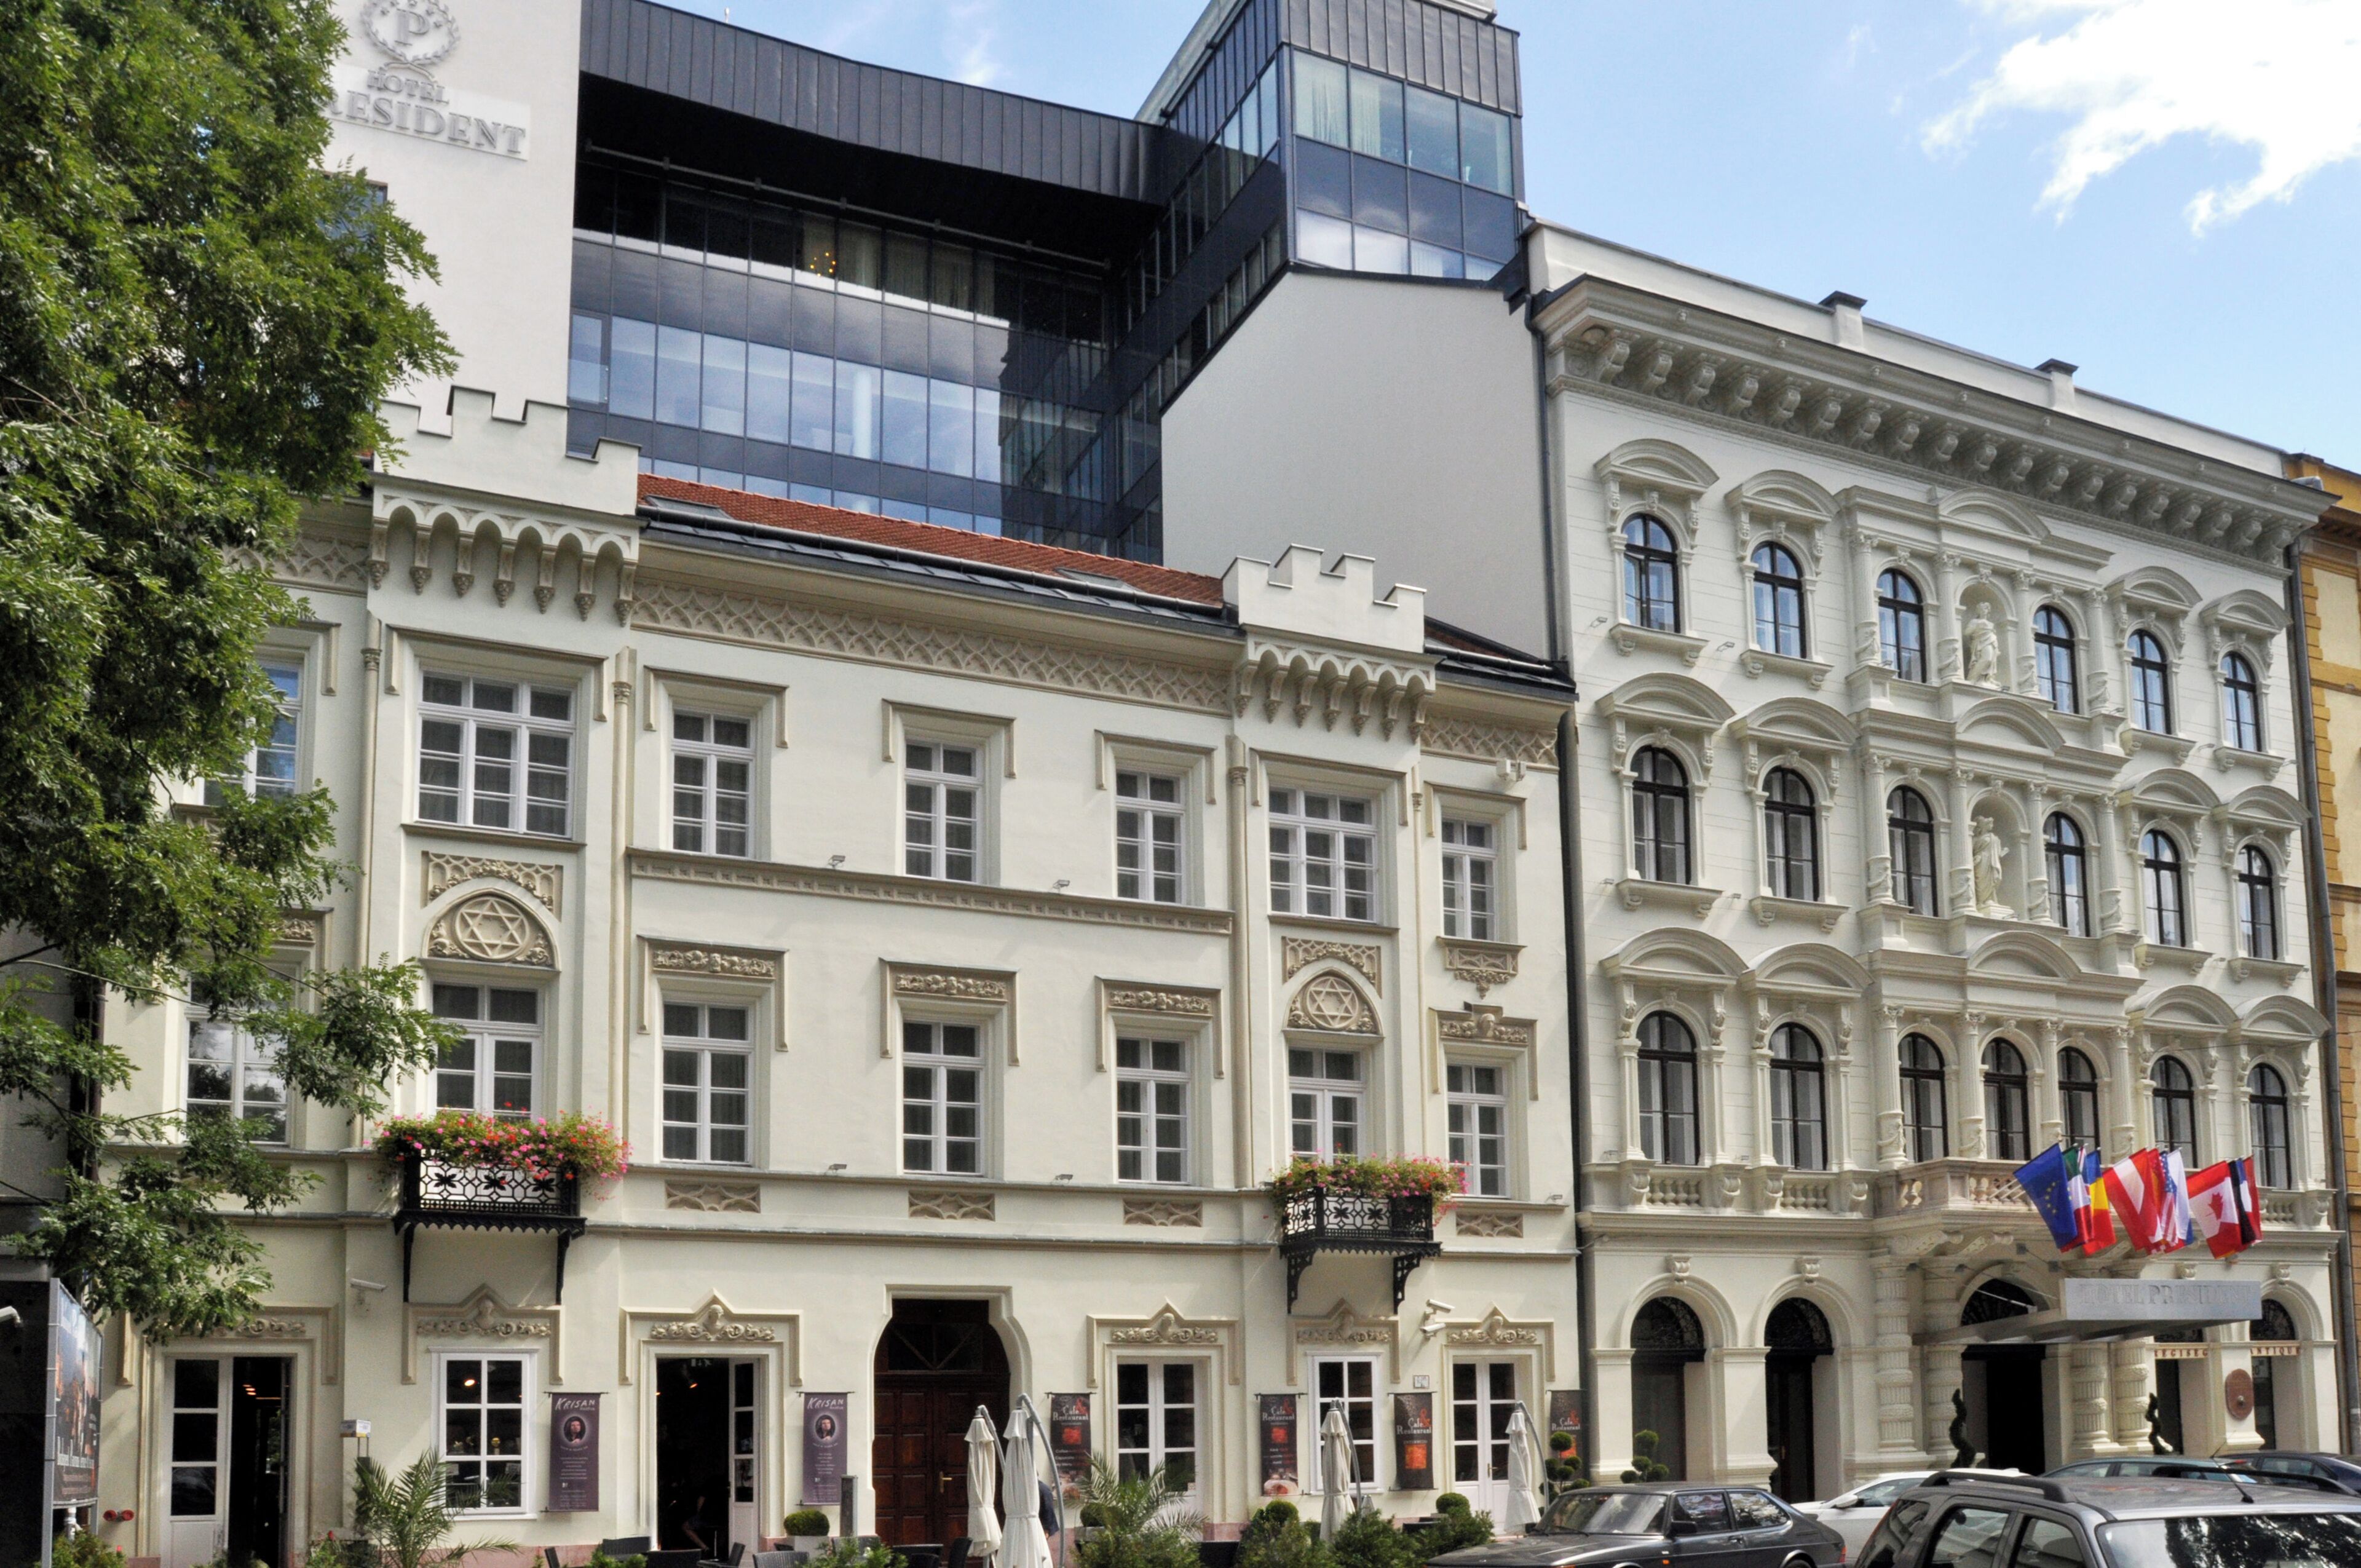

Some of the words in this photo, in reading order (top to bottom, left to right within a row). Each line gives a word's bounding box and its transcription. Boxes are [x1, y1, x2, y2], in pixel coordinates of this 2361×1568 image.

[394, 9, 430, 46] P
[367, 69, 449, 105] HOTEL
[2079, 1284, 2145, 1305] HOTEL
[2148, 1284, 2253, 1305] PRESIDENT
[1053, 1412, 1088, 1421] Restaurant
[1262, 1412, 1295, 1421] Restaurant
[1396, 1425, 1431, 1435] Restaurant
[1551, 1422, 1581, 1431] Restaurant
